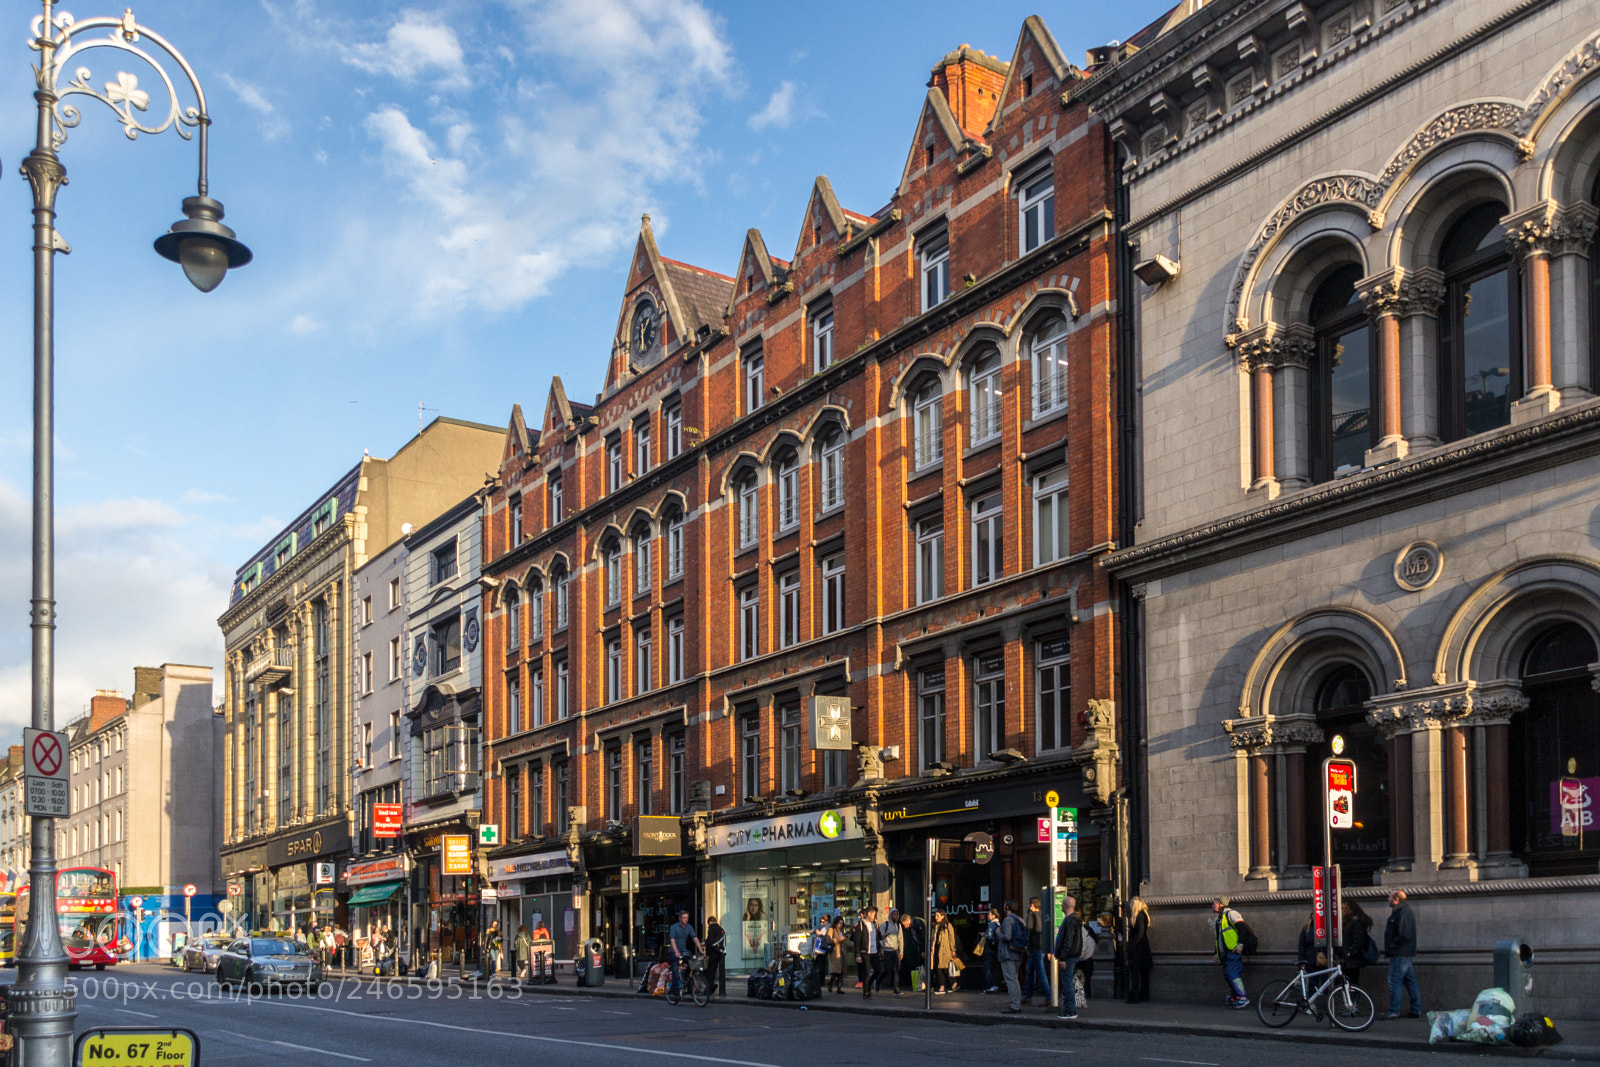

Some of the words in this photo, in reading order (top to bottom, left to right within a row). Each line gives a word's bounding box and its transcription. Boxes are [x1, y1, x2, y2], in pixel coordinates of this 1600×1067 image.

[1560, 810, 1593, 828] AIB
[288, 838, 312, 856] SPAR
[727, 829, 751, 847] CITY
[1315, 889, 1324, 916] STOP
[89, 1043, 120, 1059] No.
[127, 1043, 150, 1059] 67
[156, 1041, 172, 1050] 2nd
[156, 1051, 185, 1060] Floor
